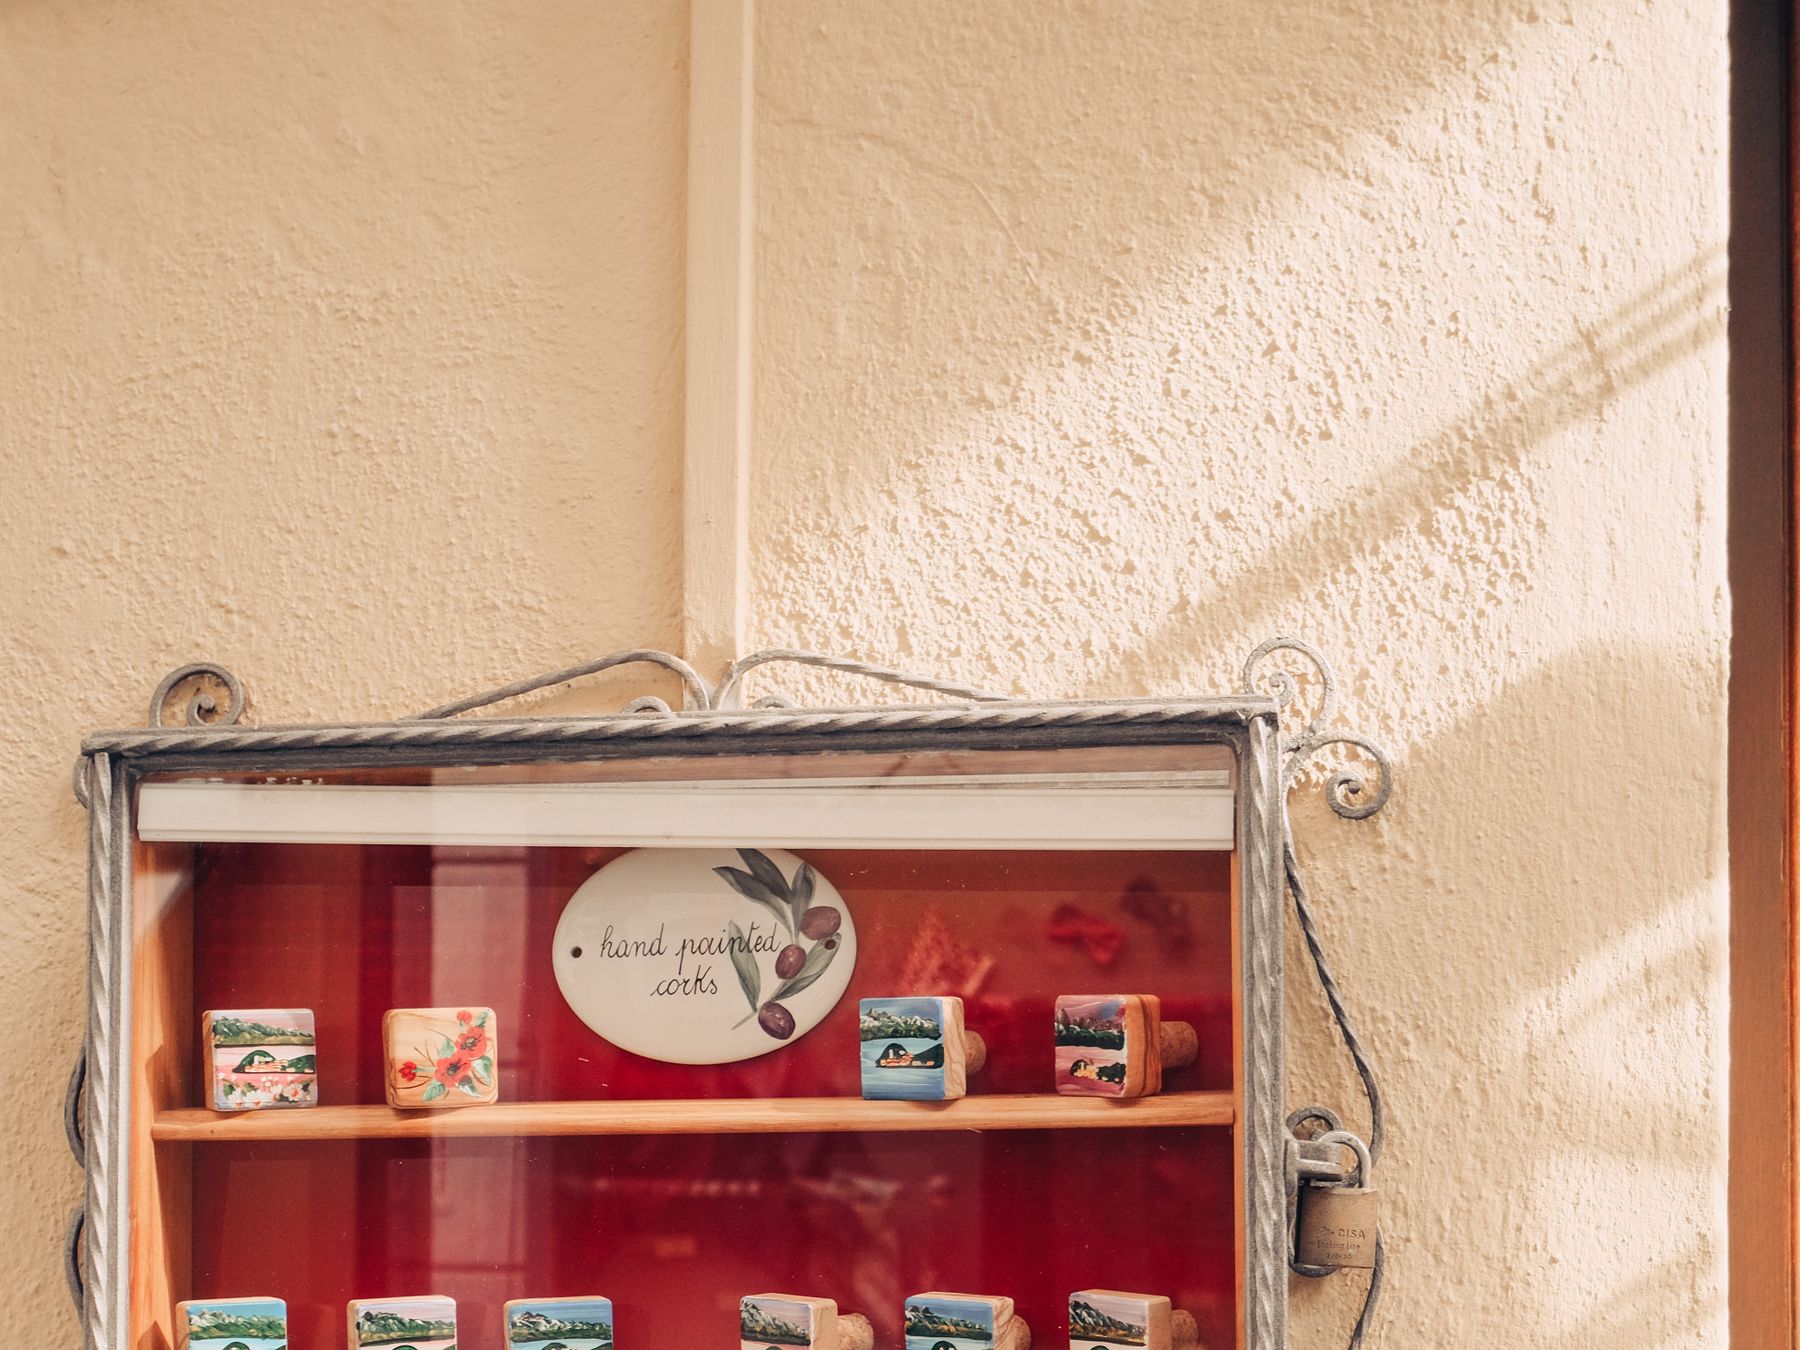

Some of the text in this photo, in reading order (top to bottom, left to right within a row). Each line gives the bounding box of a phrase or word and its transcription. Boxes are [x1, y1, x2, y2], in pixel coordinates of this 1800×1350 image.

[600, 921, 783, 975] hand painted
[650, 964, 718, 997] corks
[1338, 1228, 1366, 1240] CISA
